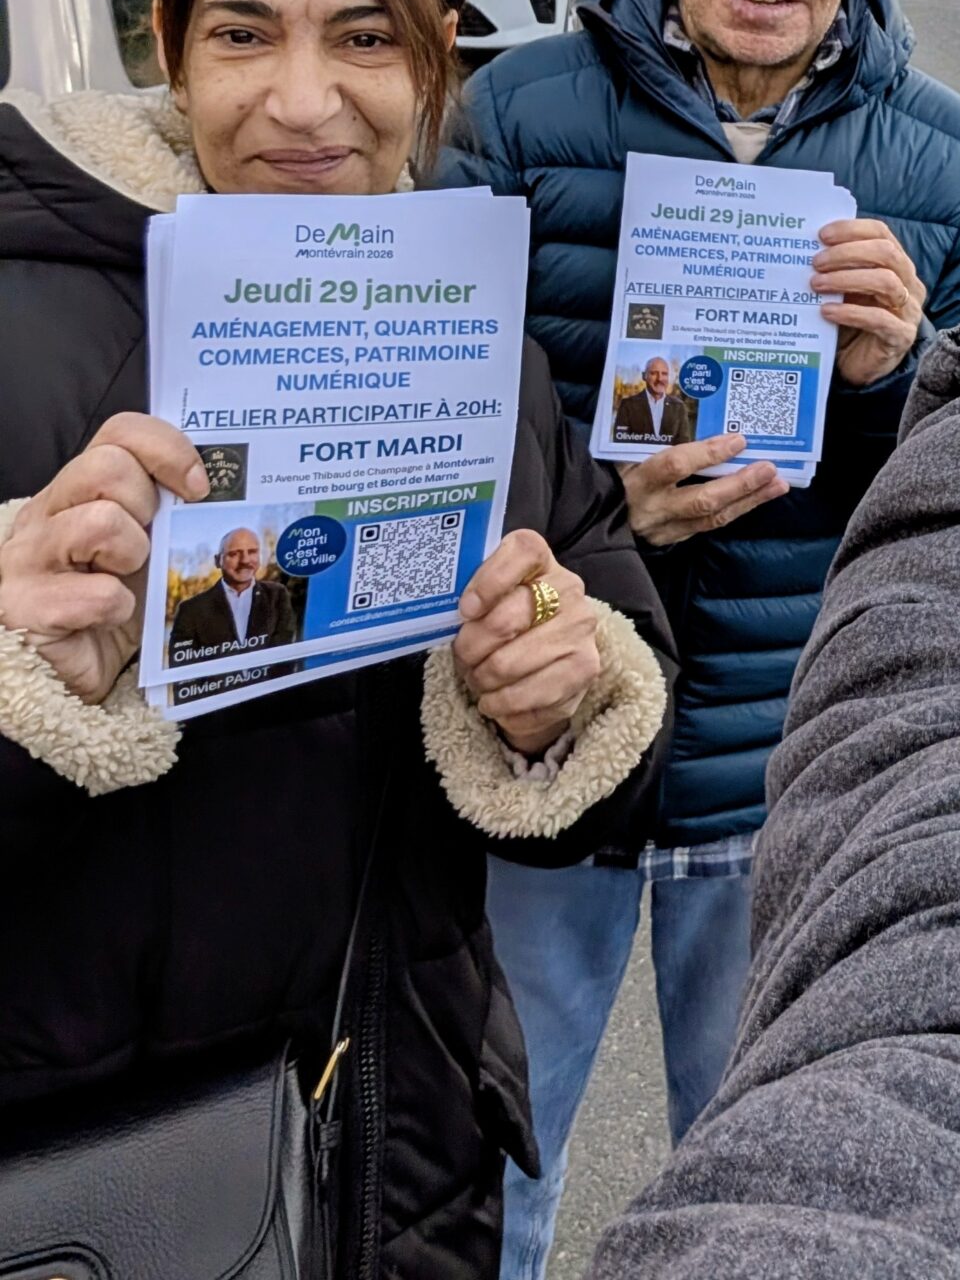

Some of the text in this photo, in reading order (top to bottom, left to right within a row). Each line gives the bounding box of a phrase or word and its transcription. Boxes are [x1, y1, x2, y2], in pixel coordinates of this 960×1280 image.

[695, 175, 756, 191] DeMain
[651, 203, 806, 229] Jeudi 29 janvier
[295, 223, 394, 247] DeMain
[630, 227, 820, 250] AMÉNAGEMENT, QUARTIERS
[295, 247, 394, 259] Montévrain 2026
[634, 244, 814, 266] COMMERCES, PATRIMOINE
[682, 263, 766, 279] NUMÉRIQUE
[223, 278, 477, 310] Jeudi 29 janvier
[625, 282, 683, 296] ATELIER
[686, 284, 778, 301] PARTICIPATIF
[780, 288, 790, 302] À
[695, 308, 797, 326] FORT MARDI
[191, 318, 499, 339] AMÉNAGEMENT, QUARTIERS
[199, 344, 489, 367] COMMERCES, PATRIMOINE
[723, 350, 809, 364] INSCRIPTION
[276, 370, 411, 391] NUMÉRIQUE
[184, 408, 277, 428] ATELIER
[282, 402, 432, 425] PARTICIPATIF
[435, 398, 451, 417] À
[456, 399, 503, 416] 20H:
[299, 434, 463, 463] FORT MARDI
[260, 475, 273, 484] 33
[274, 473, 311, 484] Avenue
[313, 470, 352, 481] Thibaud
[353, 468, 365, 478] de
[366, 464, 424, 478] Champagne
[433, 455, 495, 470] Montévrain
[298, 471, 460, 495] Entre bourg et Bord de Marne
[347, 486, 478, 516] INSCRIPTION
[288, 527, 321, 539] Mon
[297, 533, 328, 549] parti
[285, 547, 318, 560] c'est
[285, 553, 336, 568] Ma ville
[174, 634, 268, 662] Olivier PAJOT
[178, 666, 270, 699] Olivier PAJOT
